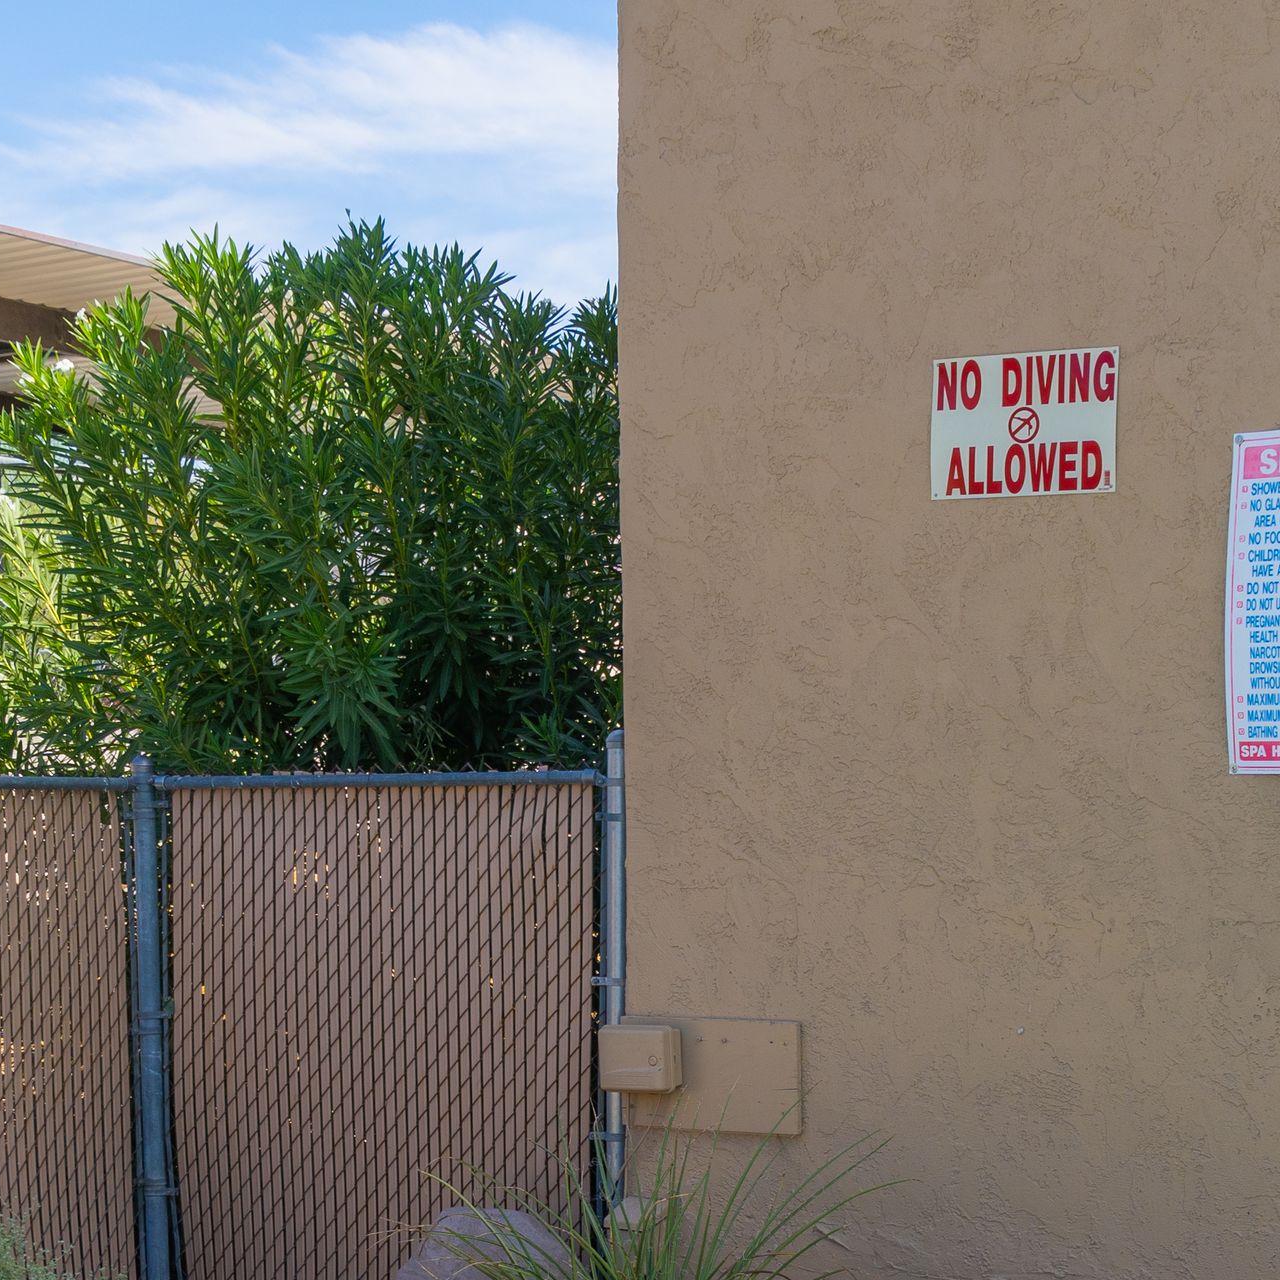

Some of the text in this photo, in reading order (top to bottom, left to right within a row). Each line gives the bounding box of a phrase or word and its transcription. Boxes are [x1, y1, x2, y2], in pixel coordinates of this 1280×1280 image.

[937, 350, 1115, 411] NO DIVING
[946, 440, 1103, 496] ALLOWED
[1250, 499, 1262, 512] NO
[1254, 514, 1276, 527] AREA
[1248, 531, 1261, 545] NO
[1251, 564, 1273, 577] HAVE
[1246, 582, 1259, 595] DO
[1262, 581, 1279, 594] NOT
[1249, 630, 1278, 643] HEALTH
[1240, 745, 1268, 759] SPA
